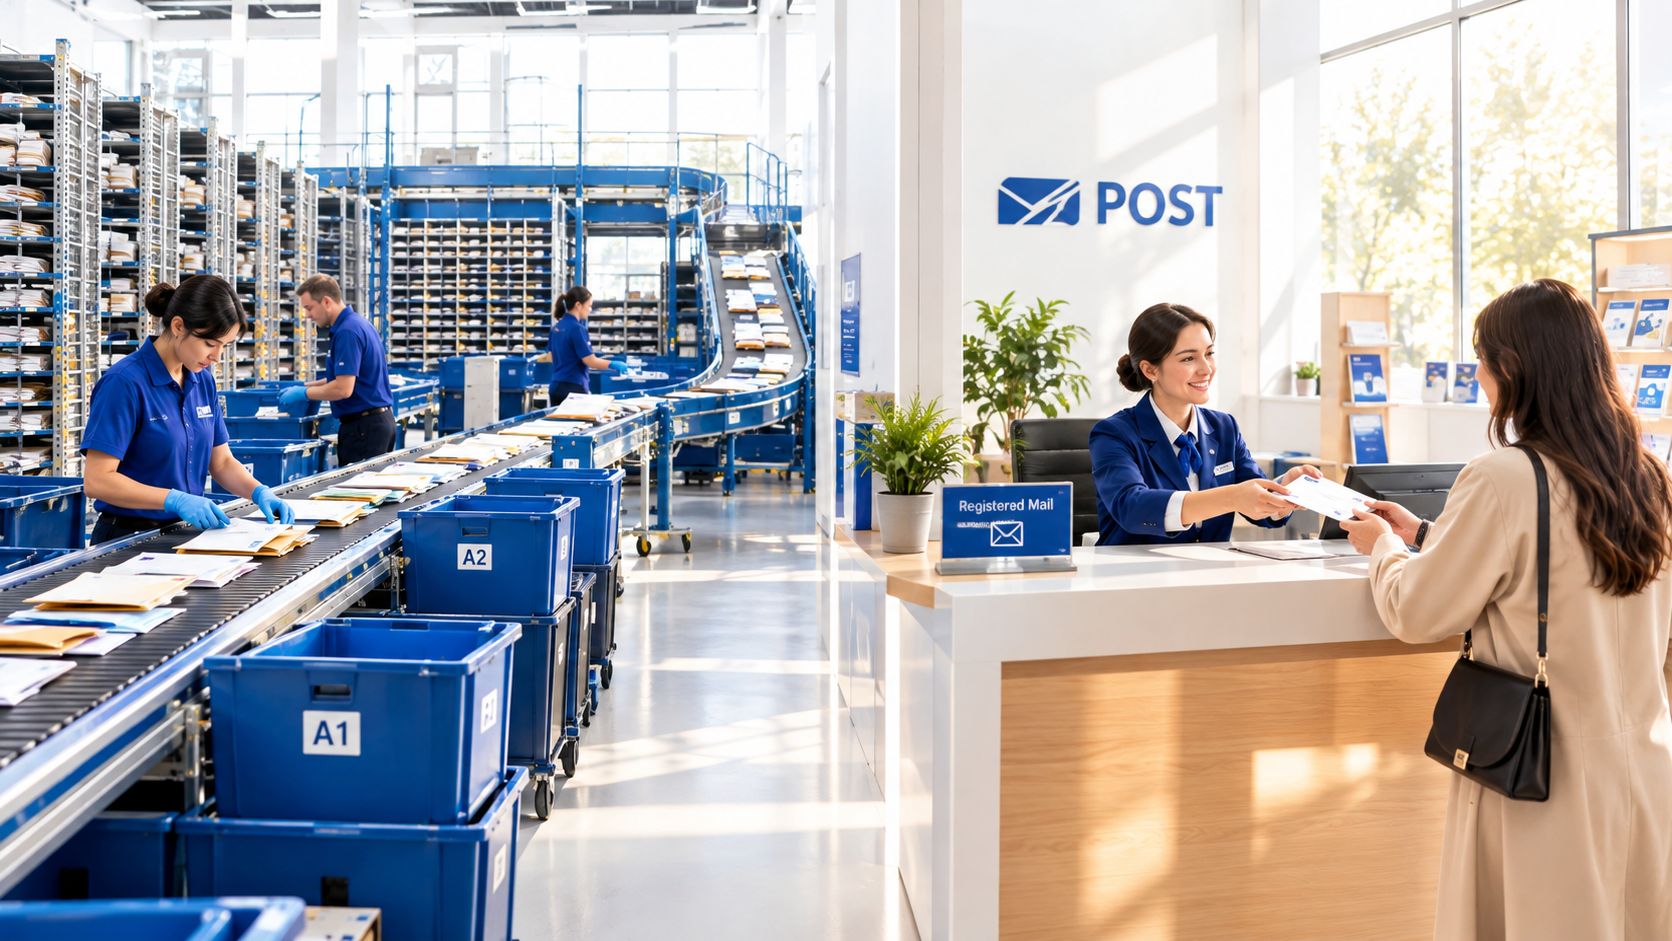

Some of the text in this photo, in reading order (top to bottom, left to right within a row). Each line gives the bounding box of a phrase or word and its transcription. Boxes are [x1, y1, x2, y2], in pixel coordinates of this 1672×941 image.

[1097, 180, 1223, 227] POST
[959, 497, 1054, 515] Registered Mail
[462, 548, 487, 566] A2
[312, 720, 347, 746] A1
